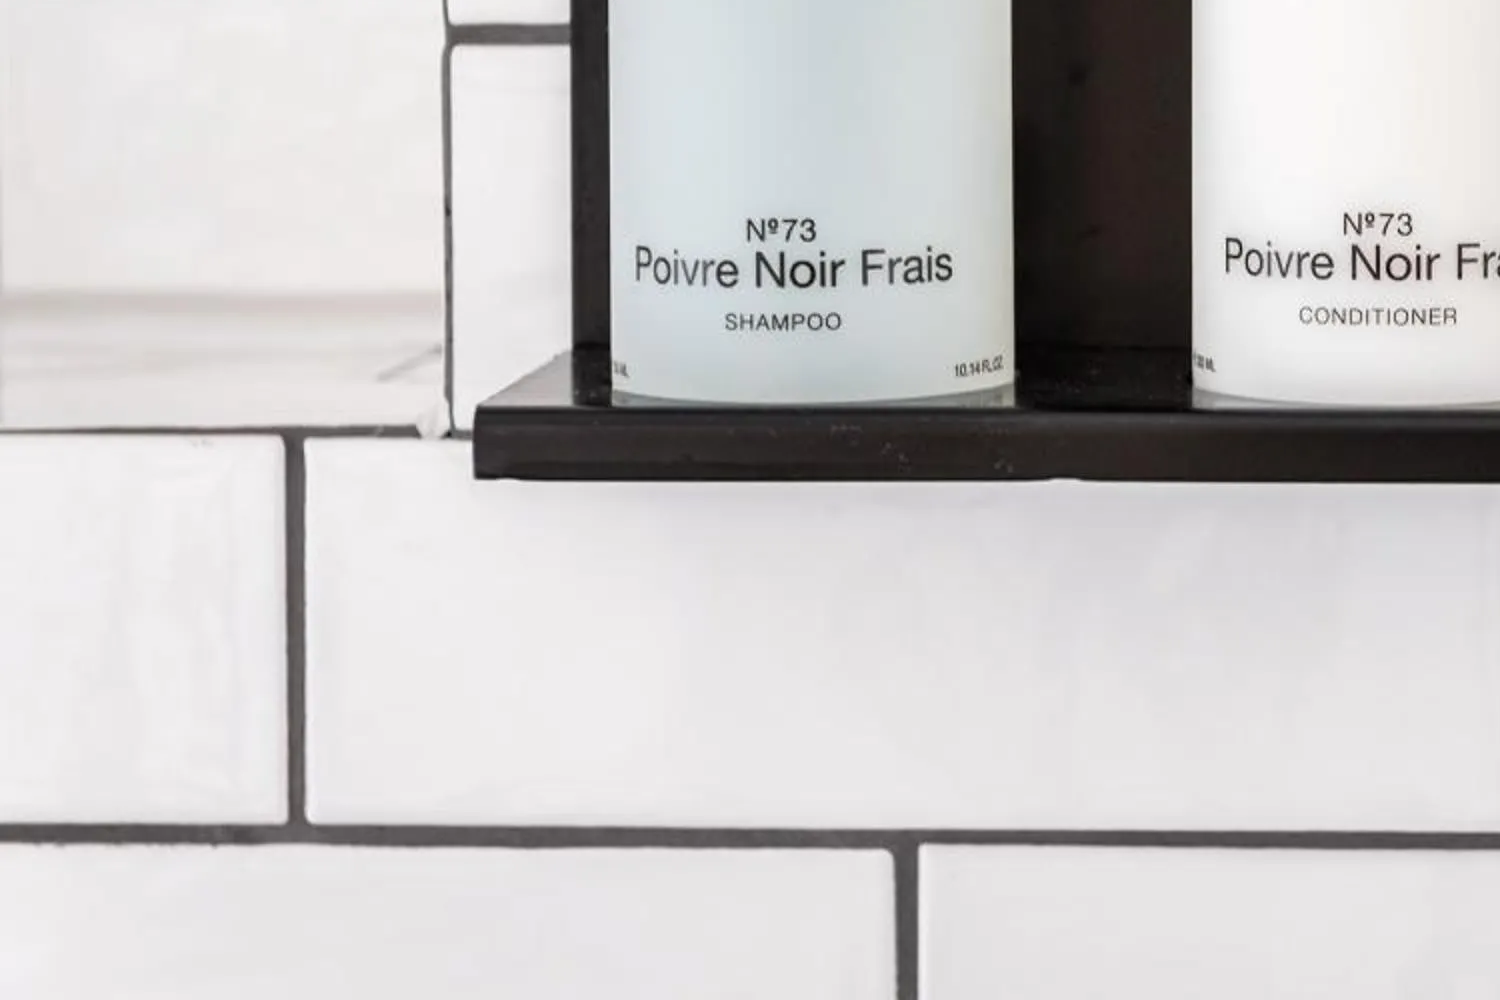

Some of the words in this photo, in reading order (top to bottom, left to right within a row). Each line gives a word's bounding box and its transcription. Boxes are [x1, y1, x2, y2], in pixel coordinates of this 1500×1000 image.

[634, 246, 739, 288] Poivre
[755, 250, 846, 289] Noir
[861, 246, 953, 287] Frais
[1224, 237, 1335, 281] Poivre
[1350, 243, 1441, 282] Noir
[725, 312, 842, 332] SHAMPOO
[1299, 307, 1458, 327] CONDITIONER
